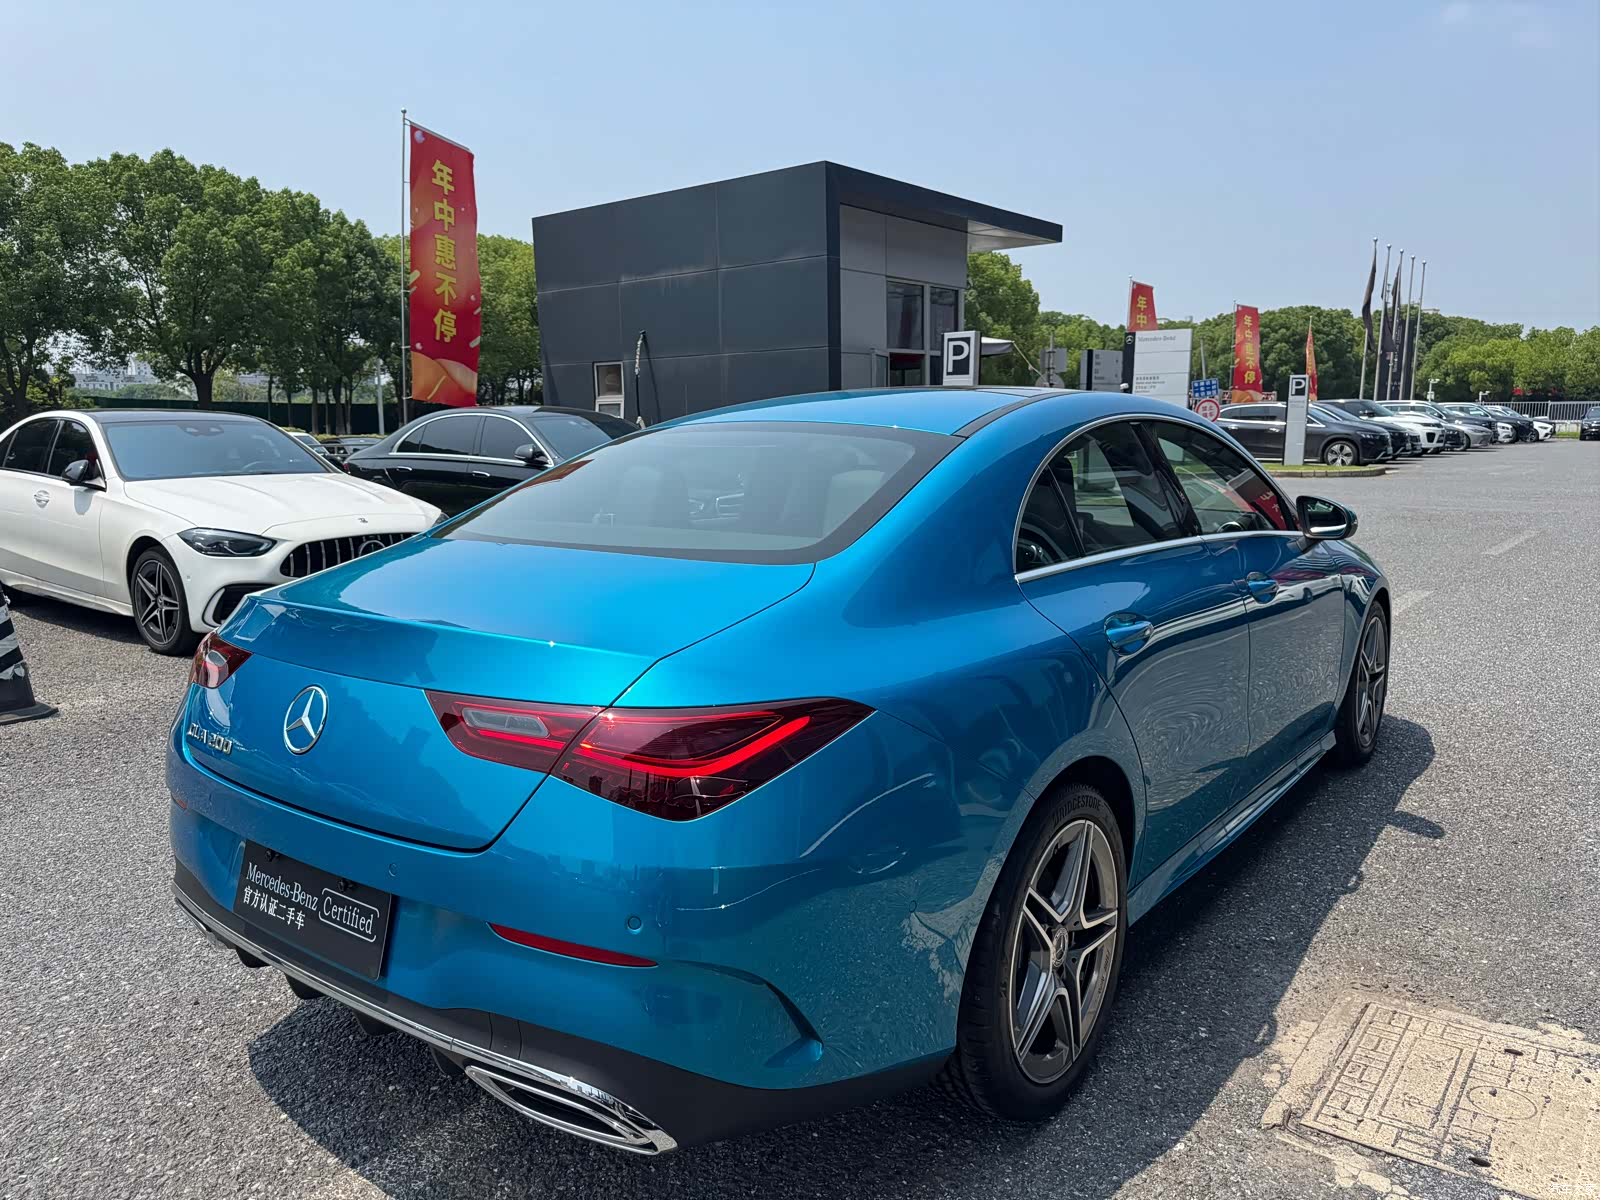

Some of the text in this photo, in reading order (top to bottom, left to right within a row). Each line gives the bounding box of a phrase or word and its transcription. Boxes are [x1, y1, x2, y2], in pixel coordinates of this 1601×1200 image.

[431, 159, 457, 343] 年中惠不停
[1136, 295, 1148, 329] 年中
[947, 340, 970, 373] P
[1291, 378, 1306, 395] P
[243, 884, 306, 930] 官方认证二手车
[245, 862, 374, 935] Mercedes-Benz Certified
